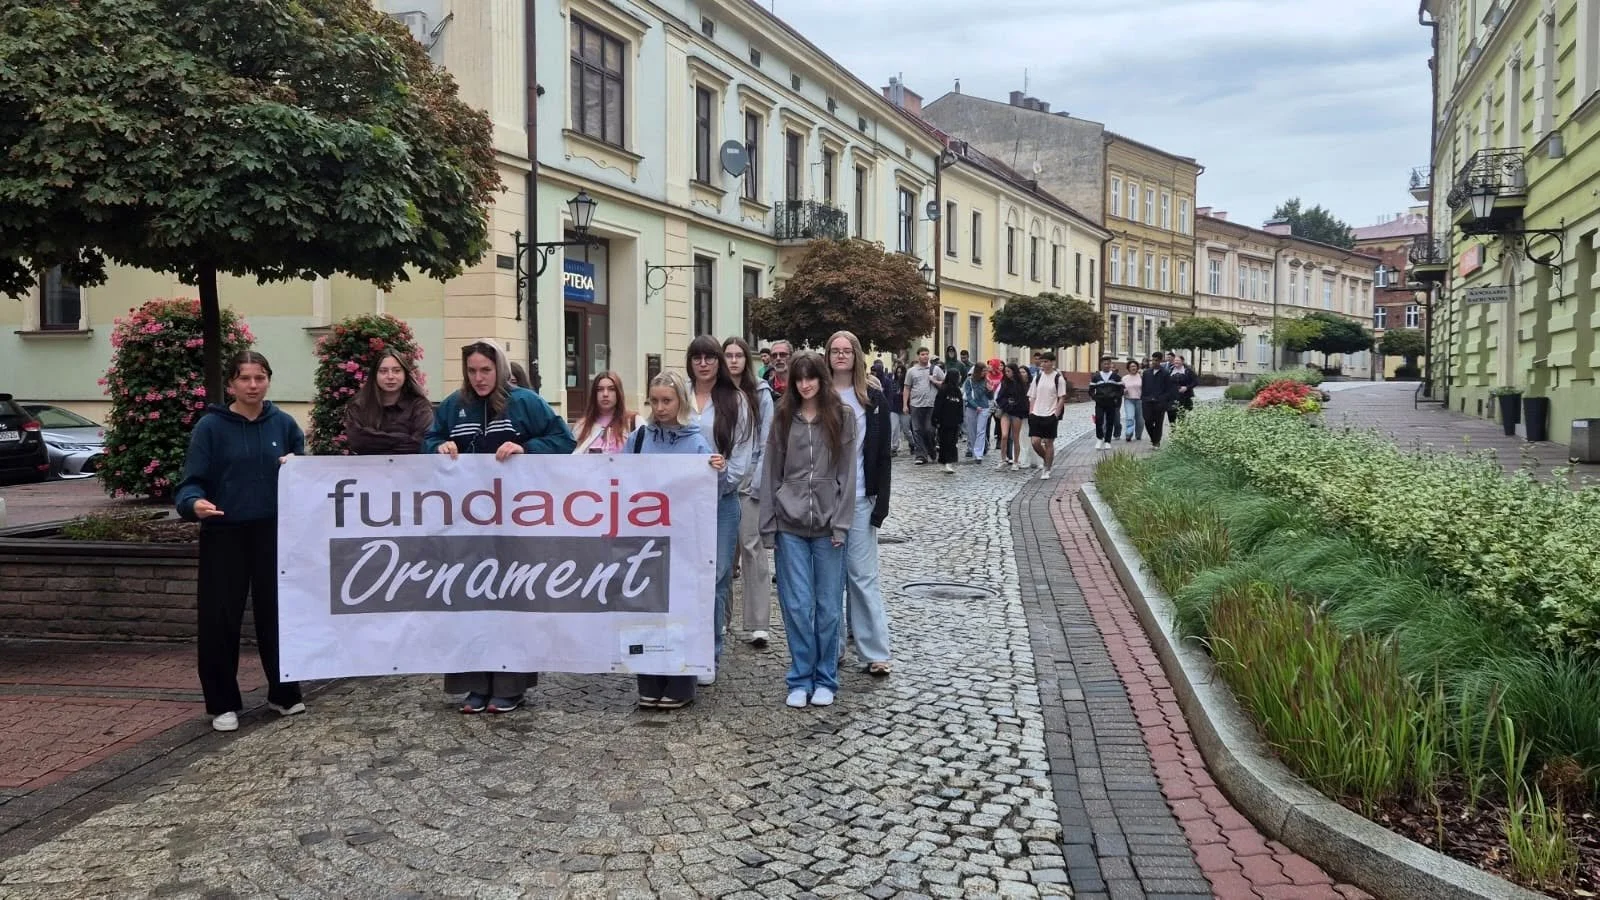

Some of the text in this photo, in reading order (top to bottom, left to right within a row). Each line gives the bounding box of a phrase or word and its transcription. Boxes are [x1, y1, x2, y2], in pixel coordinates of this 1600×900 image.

[563, 271, 594, 290] PTEKA
[327, 478, 672, 538] fundacja
[340, 538, 662, 606] Ornament
